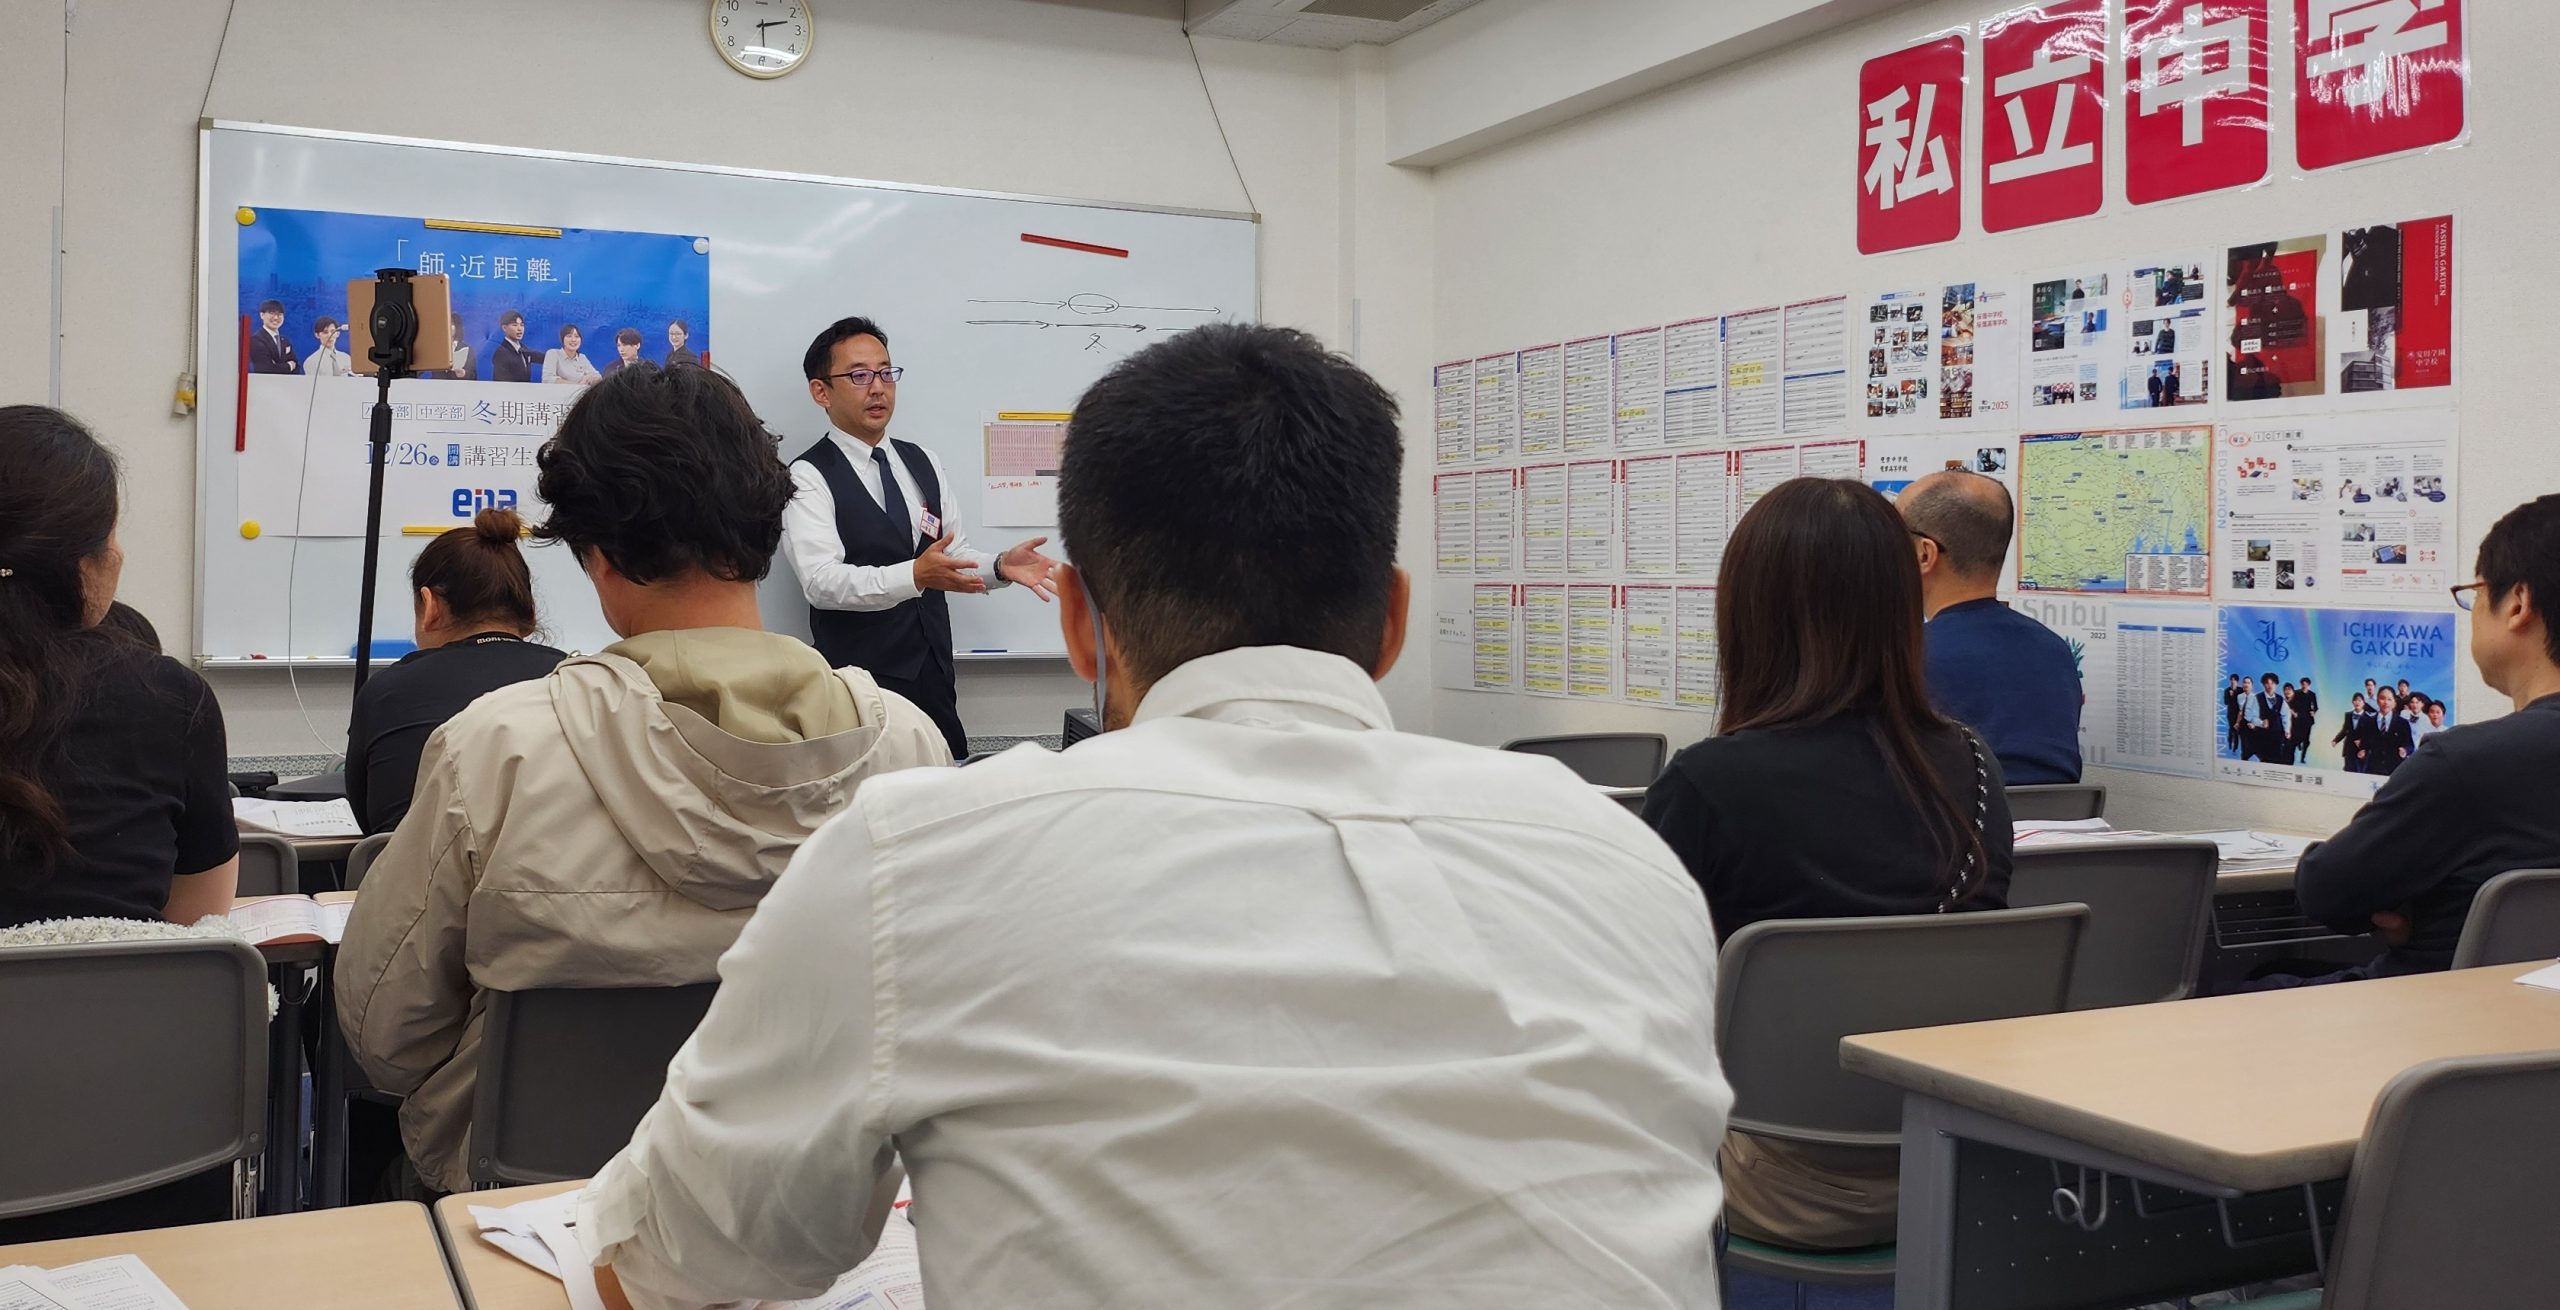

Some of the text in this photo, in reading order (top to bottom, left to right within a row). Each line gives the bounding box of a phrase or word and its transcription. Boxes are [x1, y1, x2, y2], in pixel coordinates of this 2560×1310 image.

[789, 7, 797, 18] 2
[721, 16, 729, 27] 9
[794, 25, 802, 36] 3
[727, 36, 735, 46] 8
[2439, 222, 2448, 296] YASUDA GAKUEN
[420, 406, 464, 420] 中学部
[463, 446, 534, 467] 講習生
[2217, 450, 2227, 530] EDUCATION
[2343, 622, 2443, 641] ICHIKAWA
[2351, 640, 2435, 658] GAKUEN
